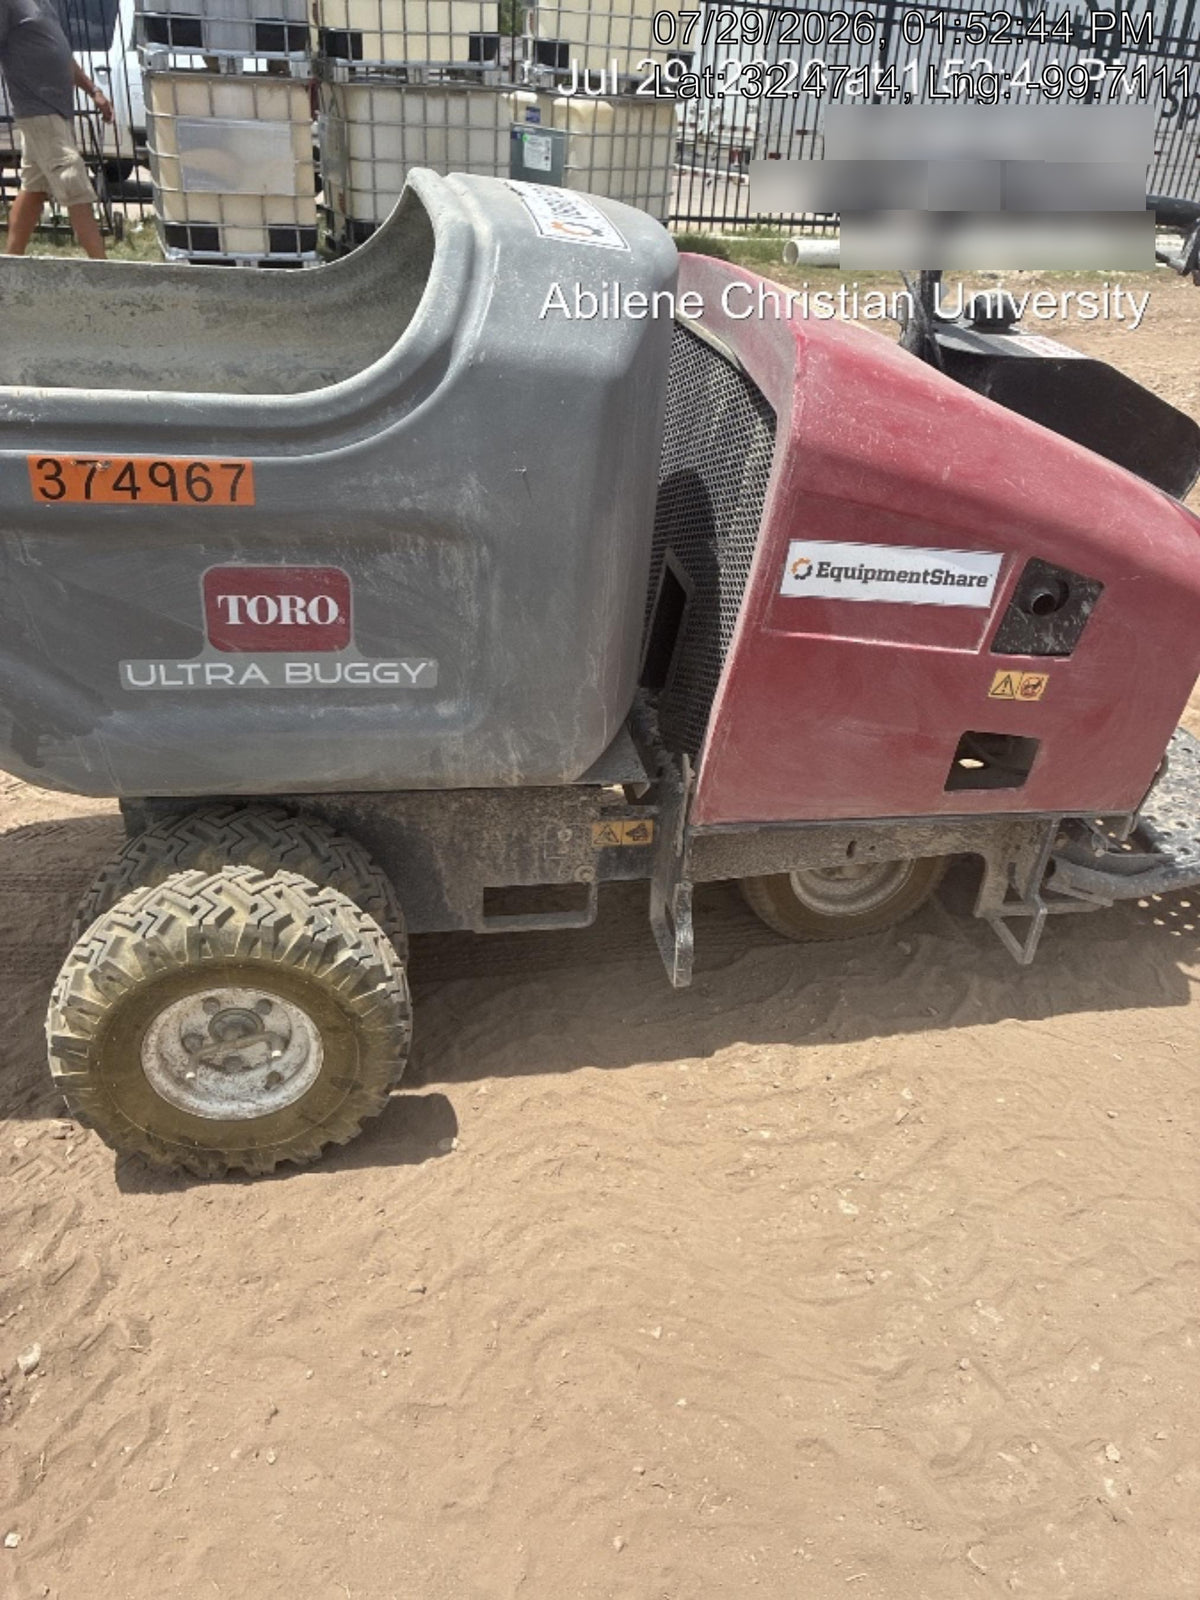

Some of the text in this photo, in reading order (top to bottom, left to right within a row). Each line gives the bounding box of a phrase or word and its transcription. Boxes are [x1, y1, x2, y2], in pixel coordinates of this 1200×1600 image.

[36, 457, 247, 503] 374967
[815, 561, 990, 588] EquipmentShare
[217, 594, 339, 625] TORO
[126, 662, 428, 686] ULTRA BUGGY
